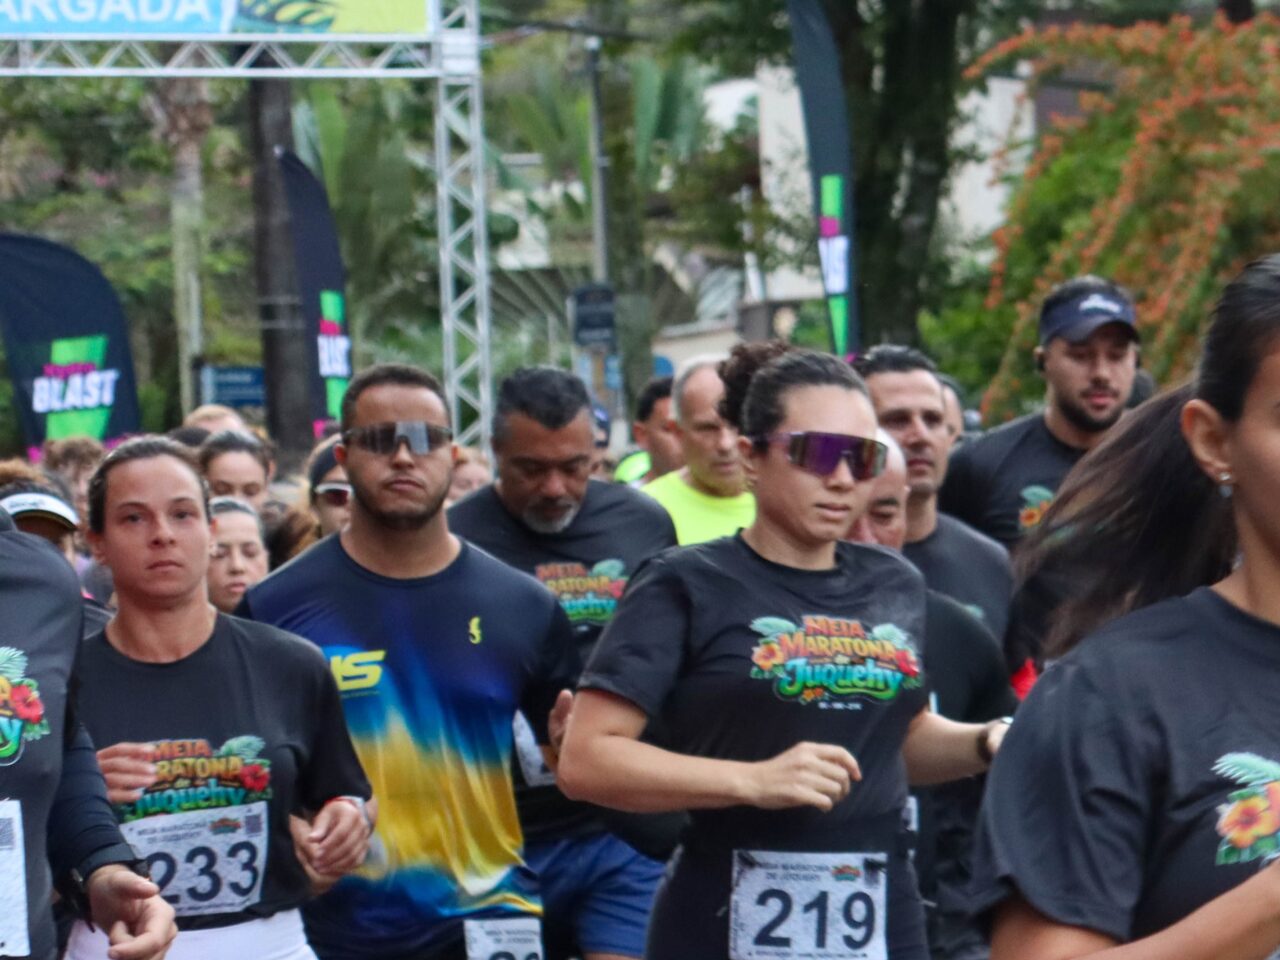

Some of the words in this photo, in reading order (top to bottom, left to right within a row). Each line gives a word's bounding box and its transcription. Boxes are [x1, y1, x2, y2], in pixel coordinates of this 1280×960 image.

[32, 368, 119, 413] BLAST
[802, 614, 865, 637] MEIA
[778, 631, 897, 661] MARATONA
[155, 756, 245, 783] RATONA
[146, 840, 260, 904] 233
[754, 888, 876, 950] 219
